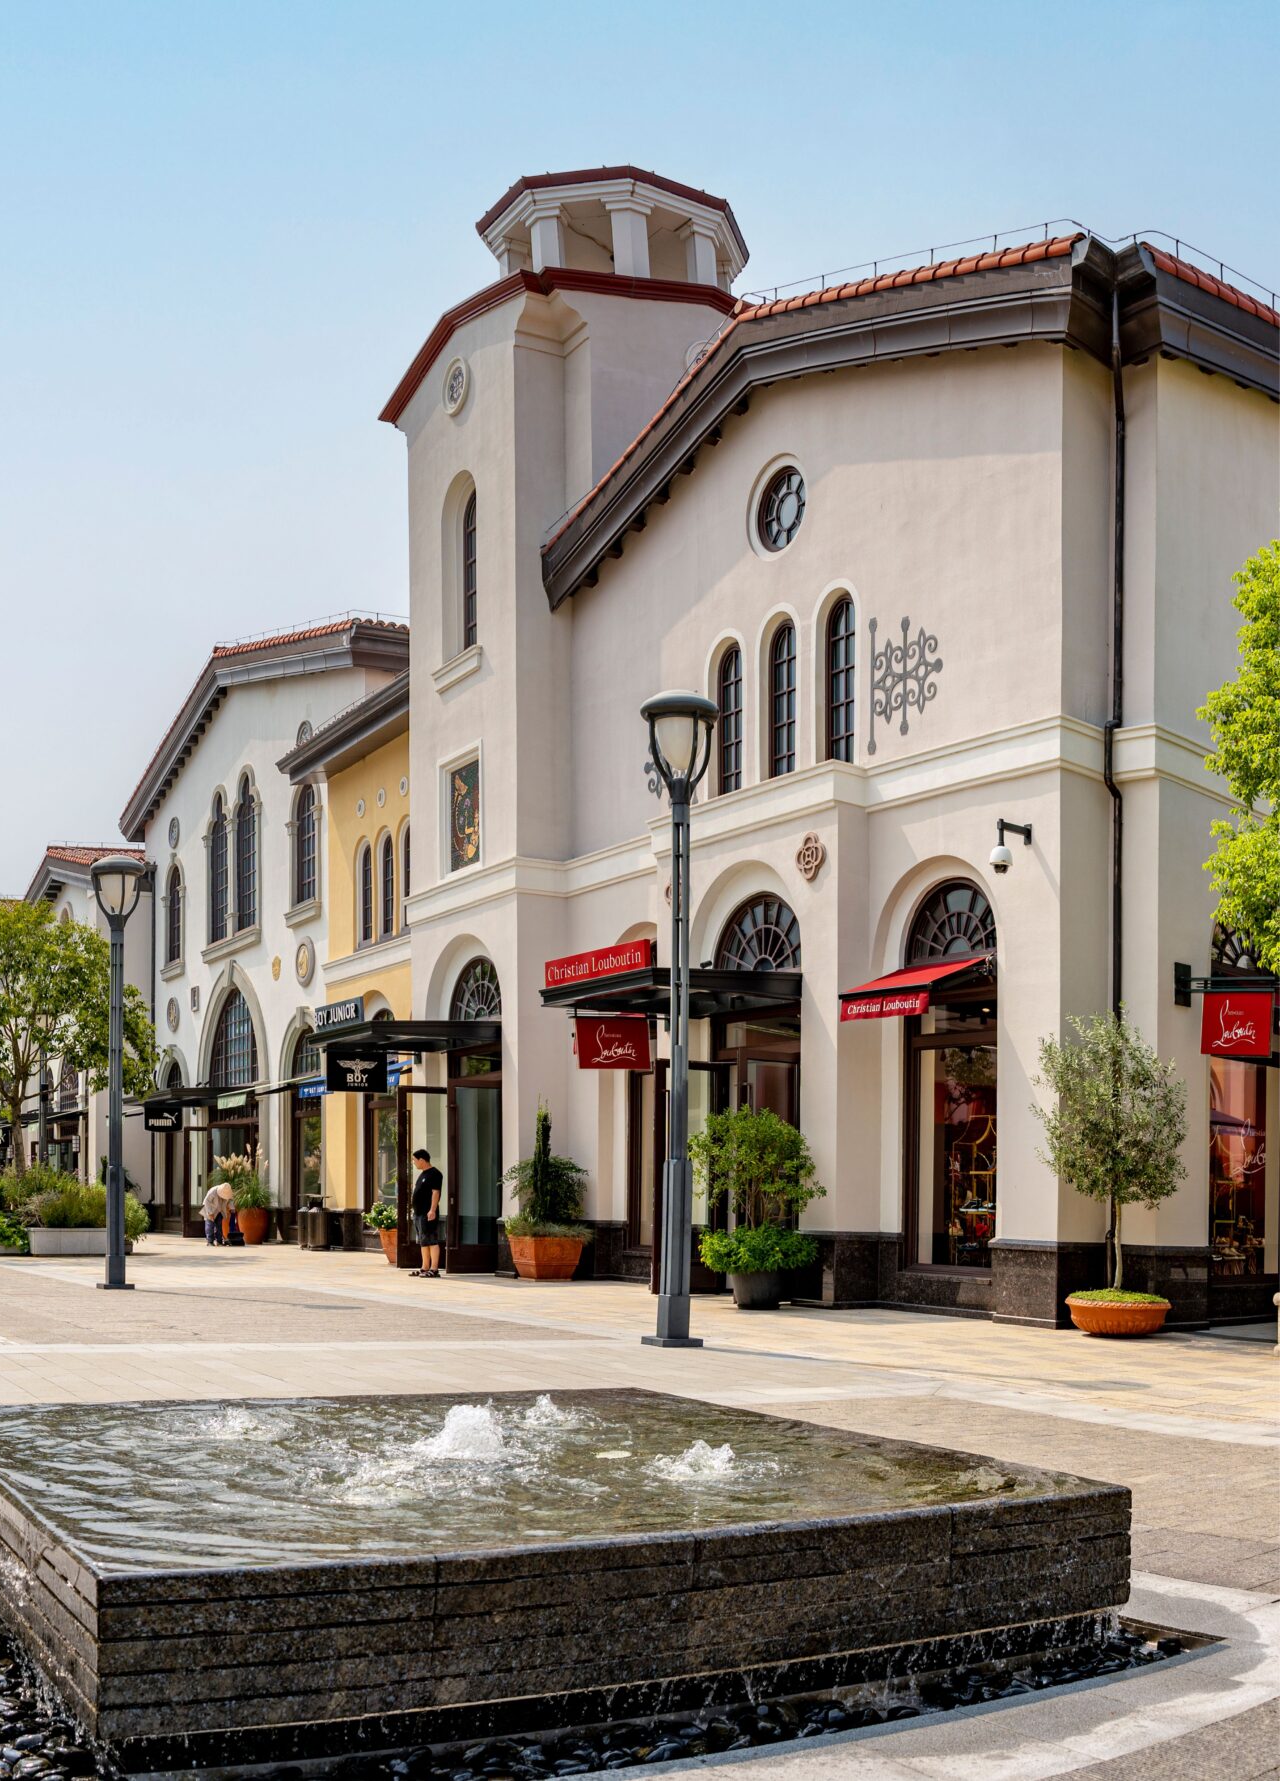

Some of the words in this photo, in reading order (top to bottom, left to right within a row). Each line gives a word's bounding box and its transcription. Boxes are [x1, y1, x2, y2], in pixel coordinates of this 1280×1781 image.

[547, 962, 589, 981] Christian
[592, 949, 641, 972] Louboutin
[847, 1003, 880, 1014] Christian
[883, 998, 920, 1011] Louboutin
[315, 1010, 328, 1027] BOY
[329, 1003, 356, 1024] JUNIOR
[346, 1073, 368, 1083] BOY
[148, 1119, 172, 1127] PUMA
